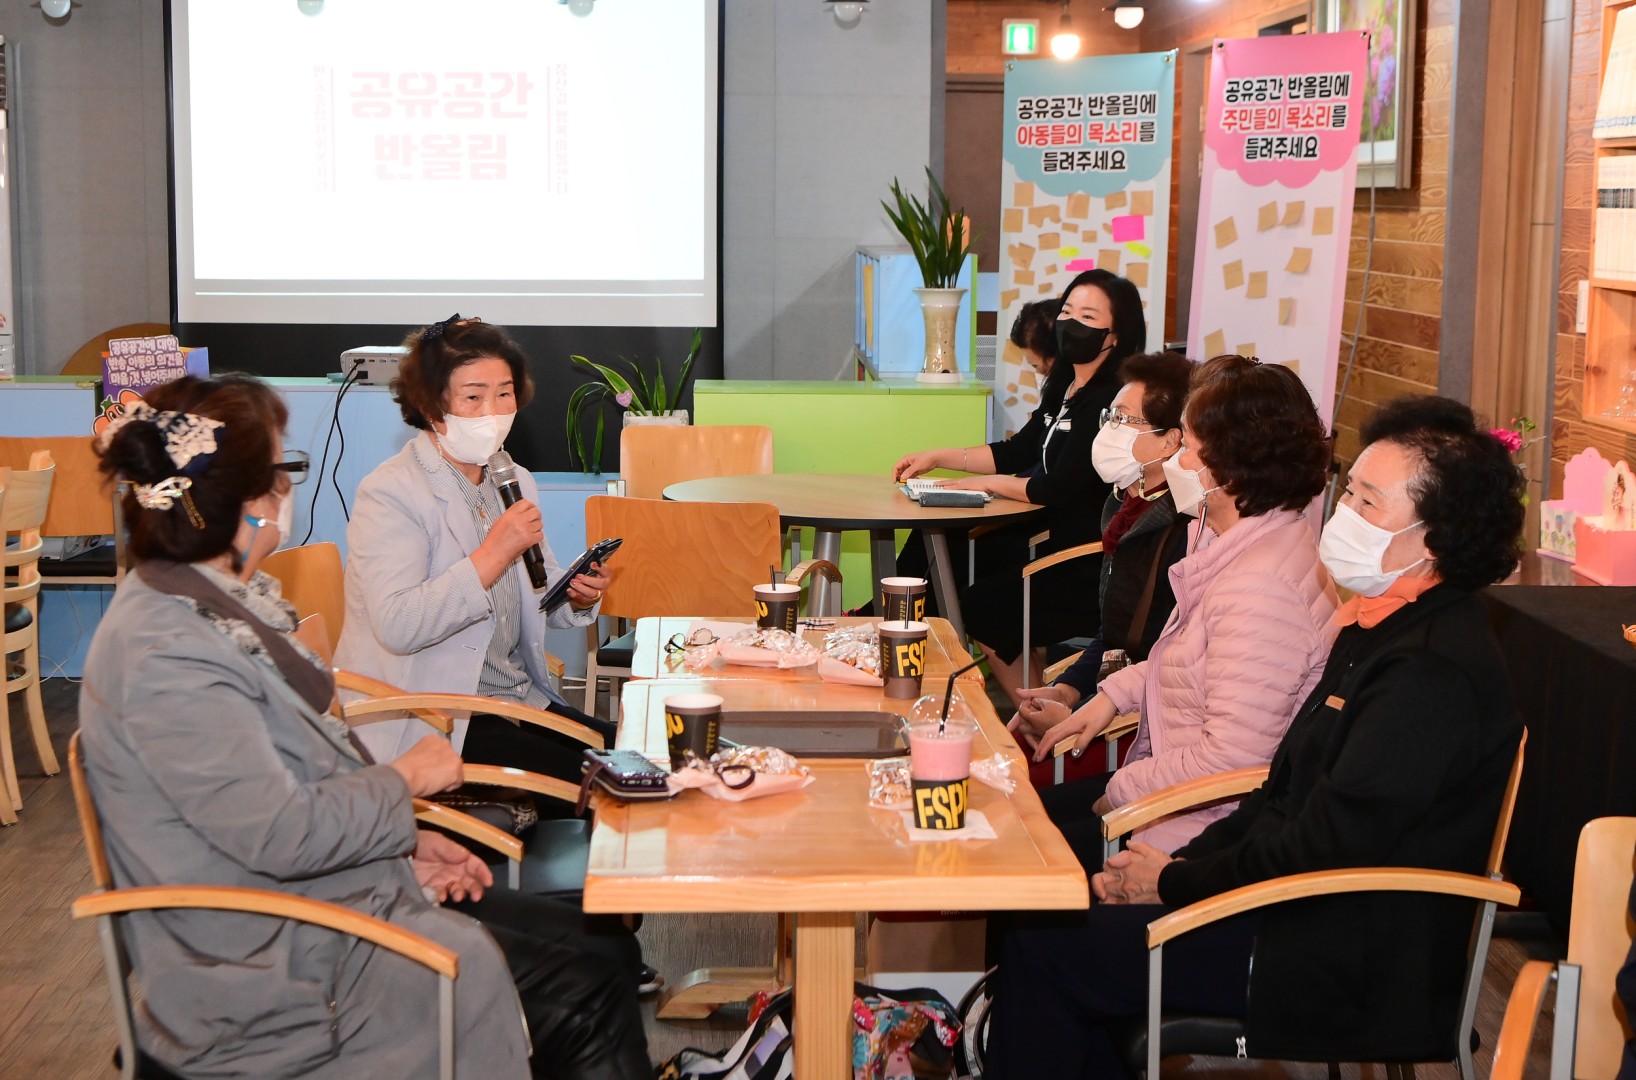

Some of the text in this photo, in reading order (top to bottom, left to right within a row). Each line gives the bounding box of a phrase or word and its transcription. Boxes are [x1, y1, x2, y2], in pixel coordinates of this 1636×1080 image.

[349, 71, 535, 119] 공유공간
[1226, 74, 1350, 103] 공유공간 반올림에
[1018, 94, 1156, 120] 공유공간 반올림에
[1222, 105, 1347, 131] 주민들의 목소리를
[1017, 121, 1155, 146] 아동들의 목소리를
[373, 133, 508, 180] 반올림
[1245, 136, 1318, 160] 들려주세요
[1043, 150, 1126, 172] 들려주세요
[111, 336, 176, 356] 공유공간에 대한
[108, 350, 184, 371] 반송 아동의 의견을
